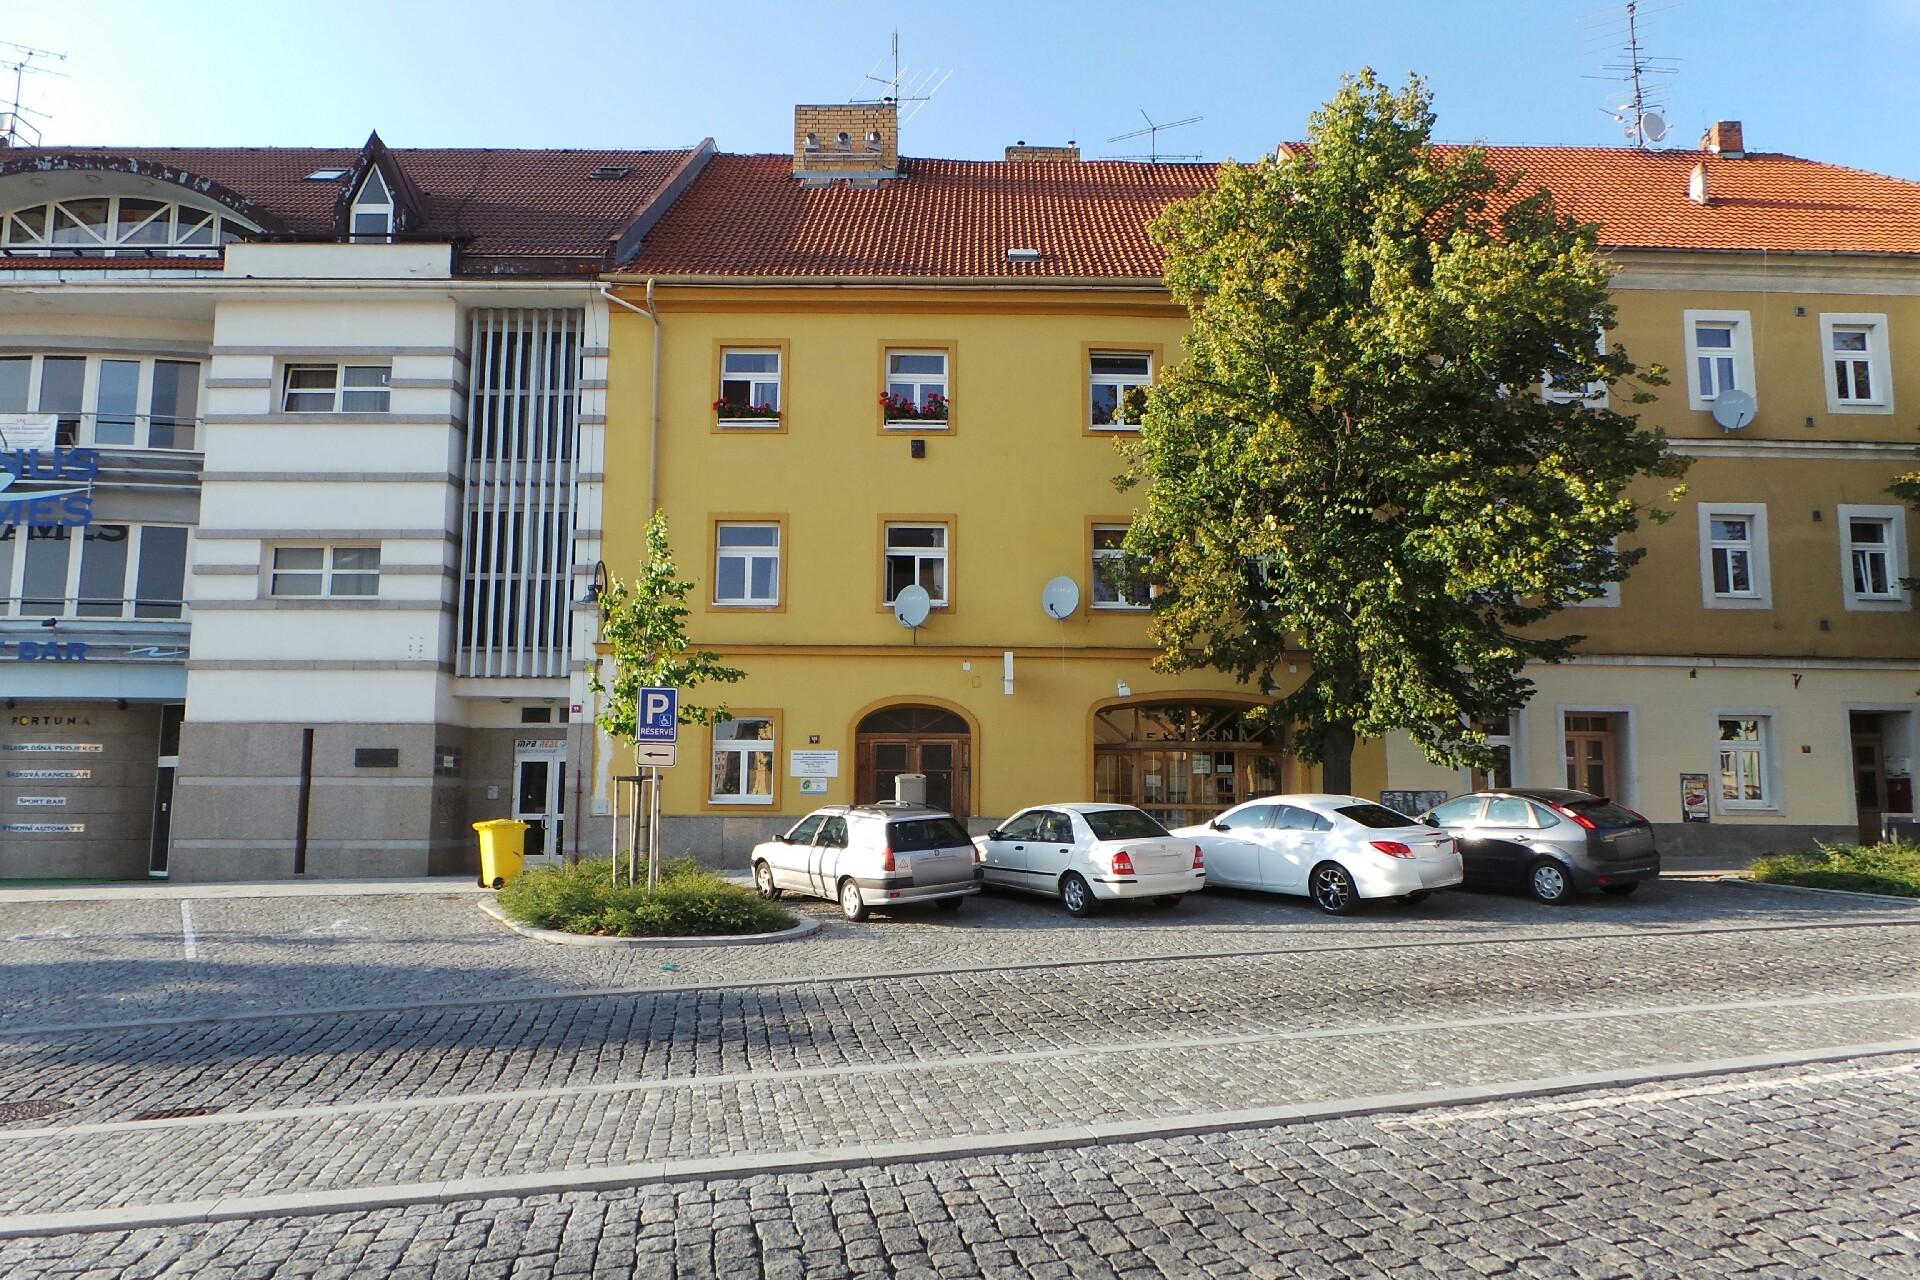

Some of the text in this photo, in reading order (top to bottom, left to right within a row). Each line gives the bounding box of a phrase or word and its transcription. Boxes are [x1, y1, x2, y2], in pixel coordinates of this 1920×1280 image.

[19, 641, 87, 660] BAR
[647, 694, 669, 725] P
[12, 715, 90, 726] FORTUNA
